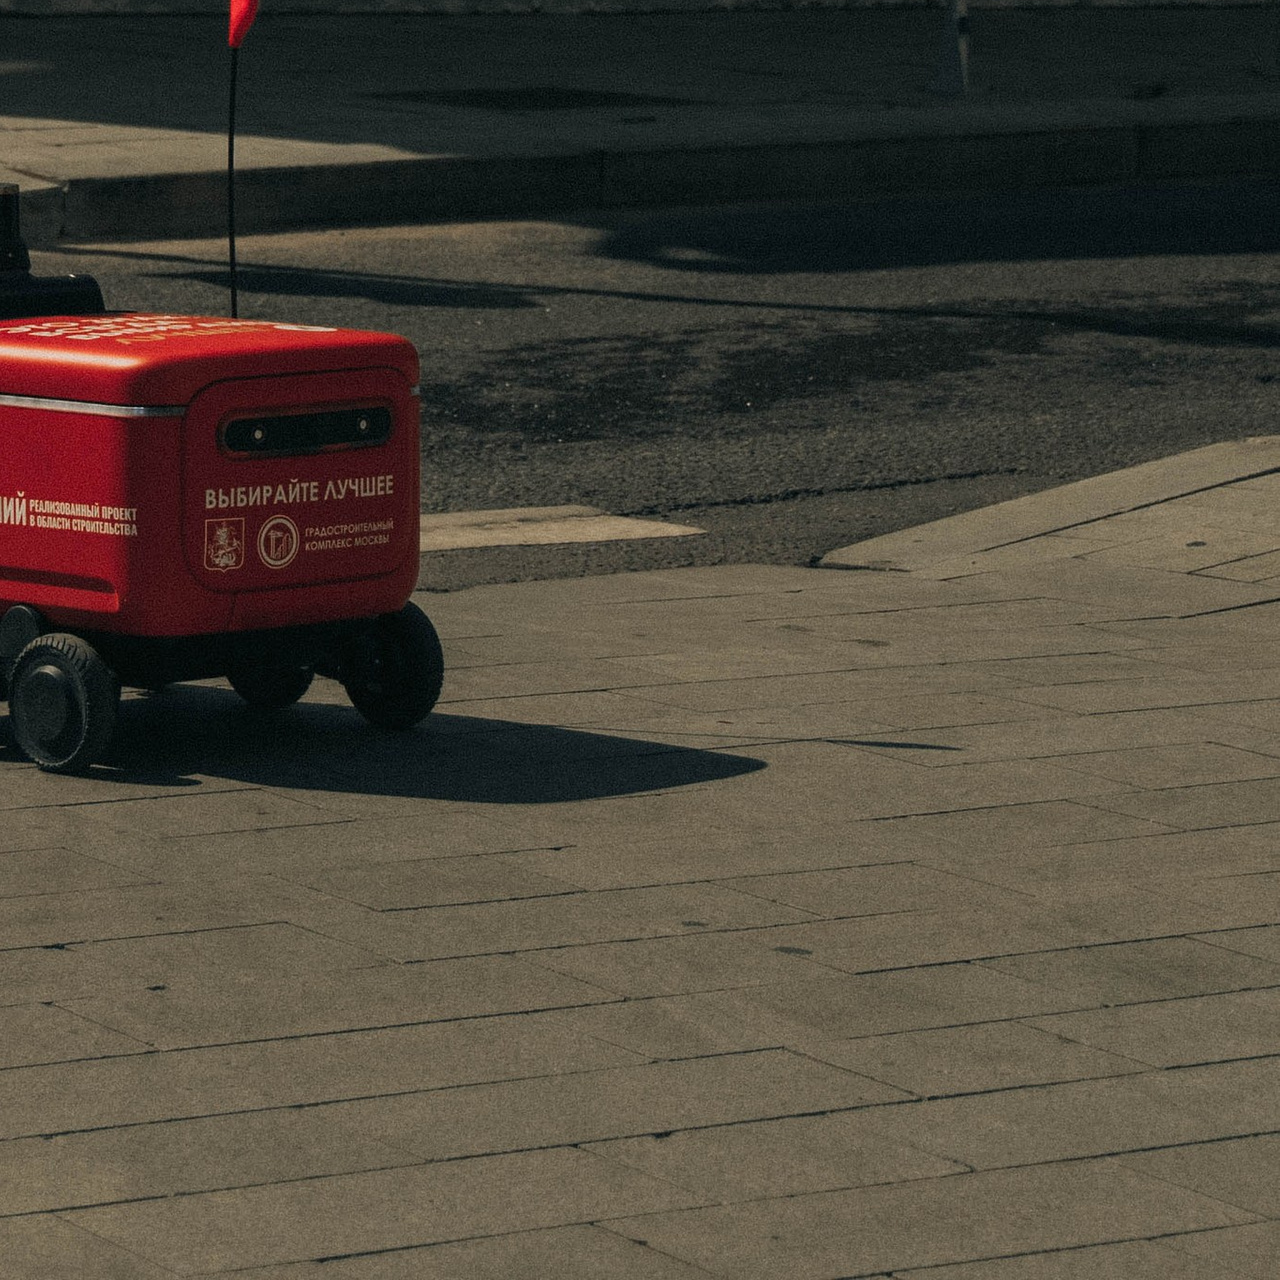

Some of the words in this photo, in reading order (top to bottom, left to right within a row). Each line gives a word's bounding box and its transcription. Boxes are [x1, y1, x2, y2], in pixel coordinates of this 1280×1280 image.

[205, 478, 319, 509] ВЫБИРАЙТЕ
[324, 475, 394, 500] ЛУЧШЕЕ
[29, 499, 100, 518] РЕАЛИЗОВАННЫЙ
[101, 506, 137, 521] ПРОЕКТ
[29, 515, 36, 526] В
[37, 515, 71, 530] ОБЛАСТИ
[72, 519, 138, 536] СТРОИТЕЛЬСТВА
[304, 517, 394, 538] ГРАДОСТРОИТЕЛЬНЫЙ
[305, 537, 353, 551] КОМПЛЕКС
[354, 534, 390, 547] МОСКВЫ
